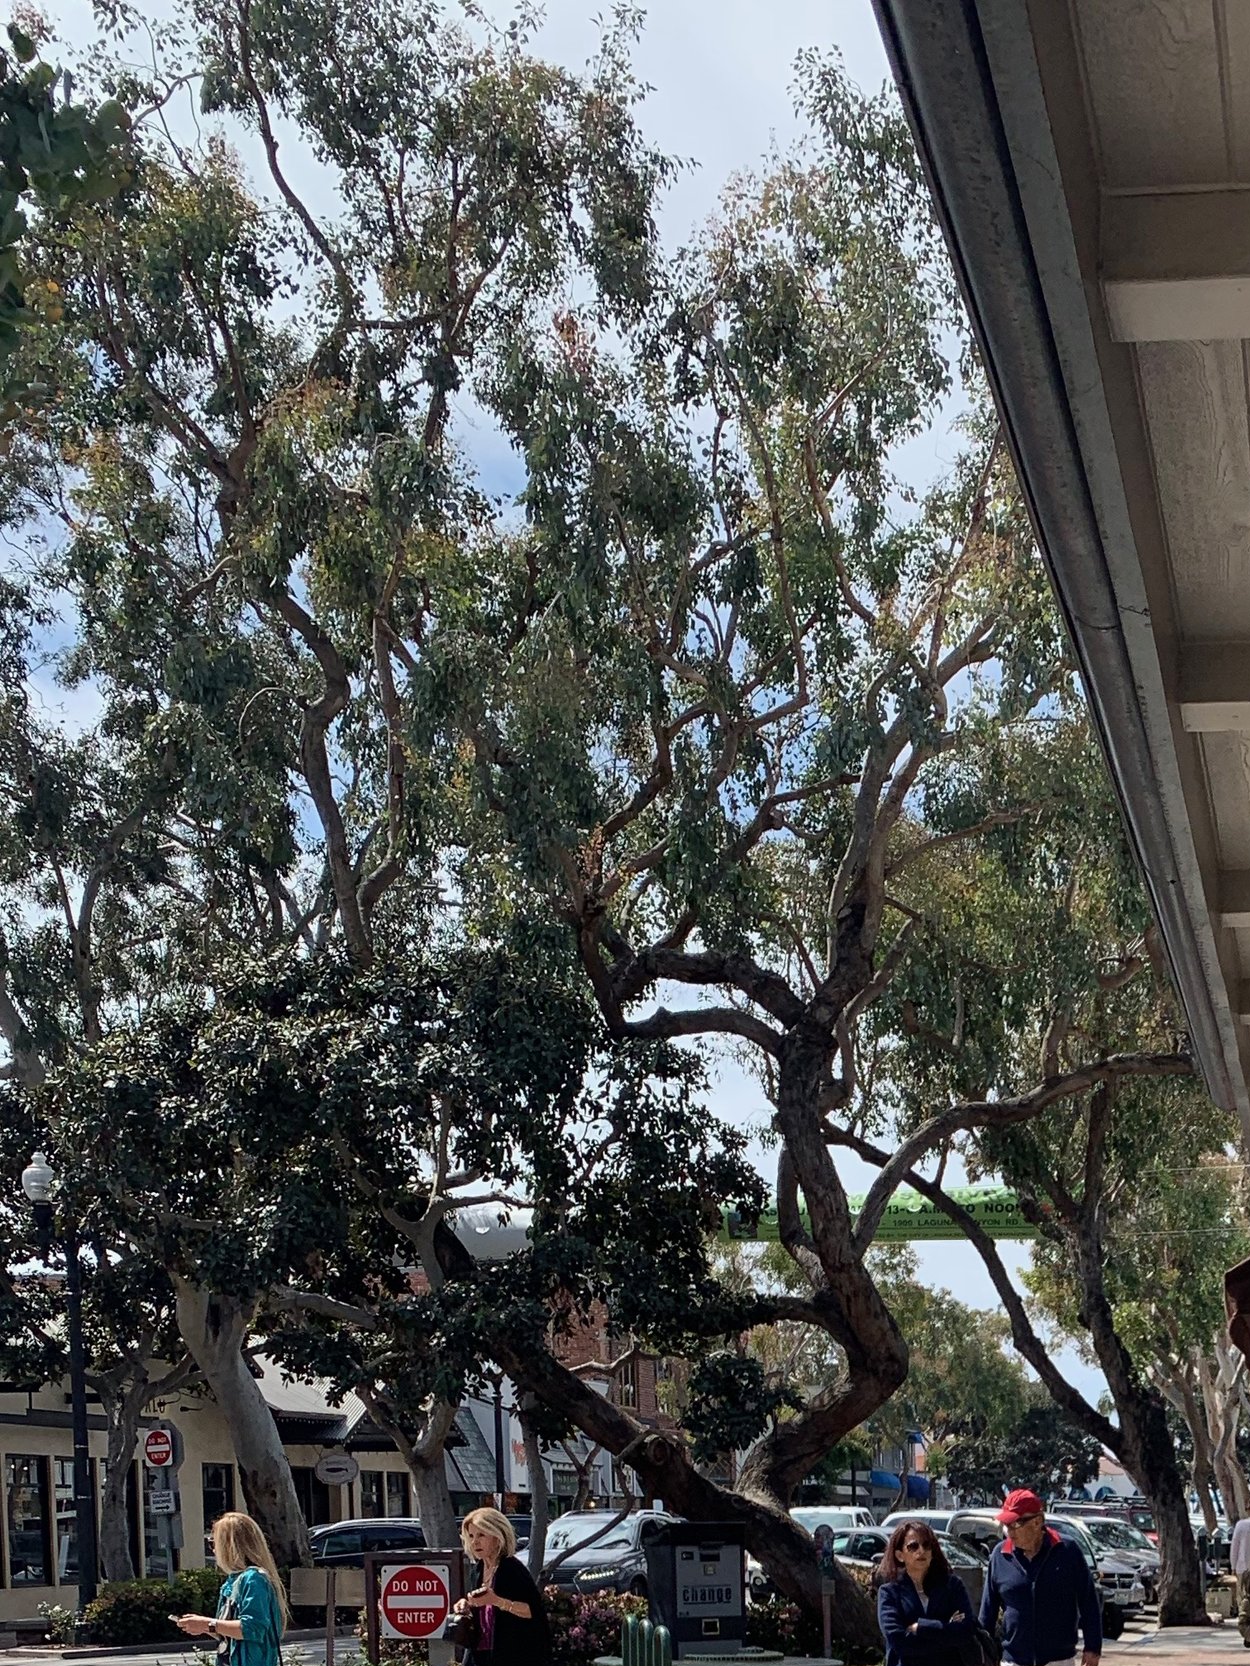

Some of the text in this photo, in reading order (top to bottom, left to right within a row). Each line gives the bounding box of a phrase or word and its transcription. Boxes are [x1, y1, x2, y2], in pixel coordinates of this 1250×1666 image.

[392, 1580, 438, 1592] DO NOT
[683, 1587, 732, 1603] change
[397, 1611, 435, 1623] ENTER
